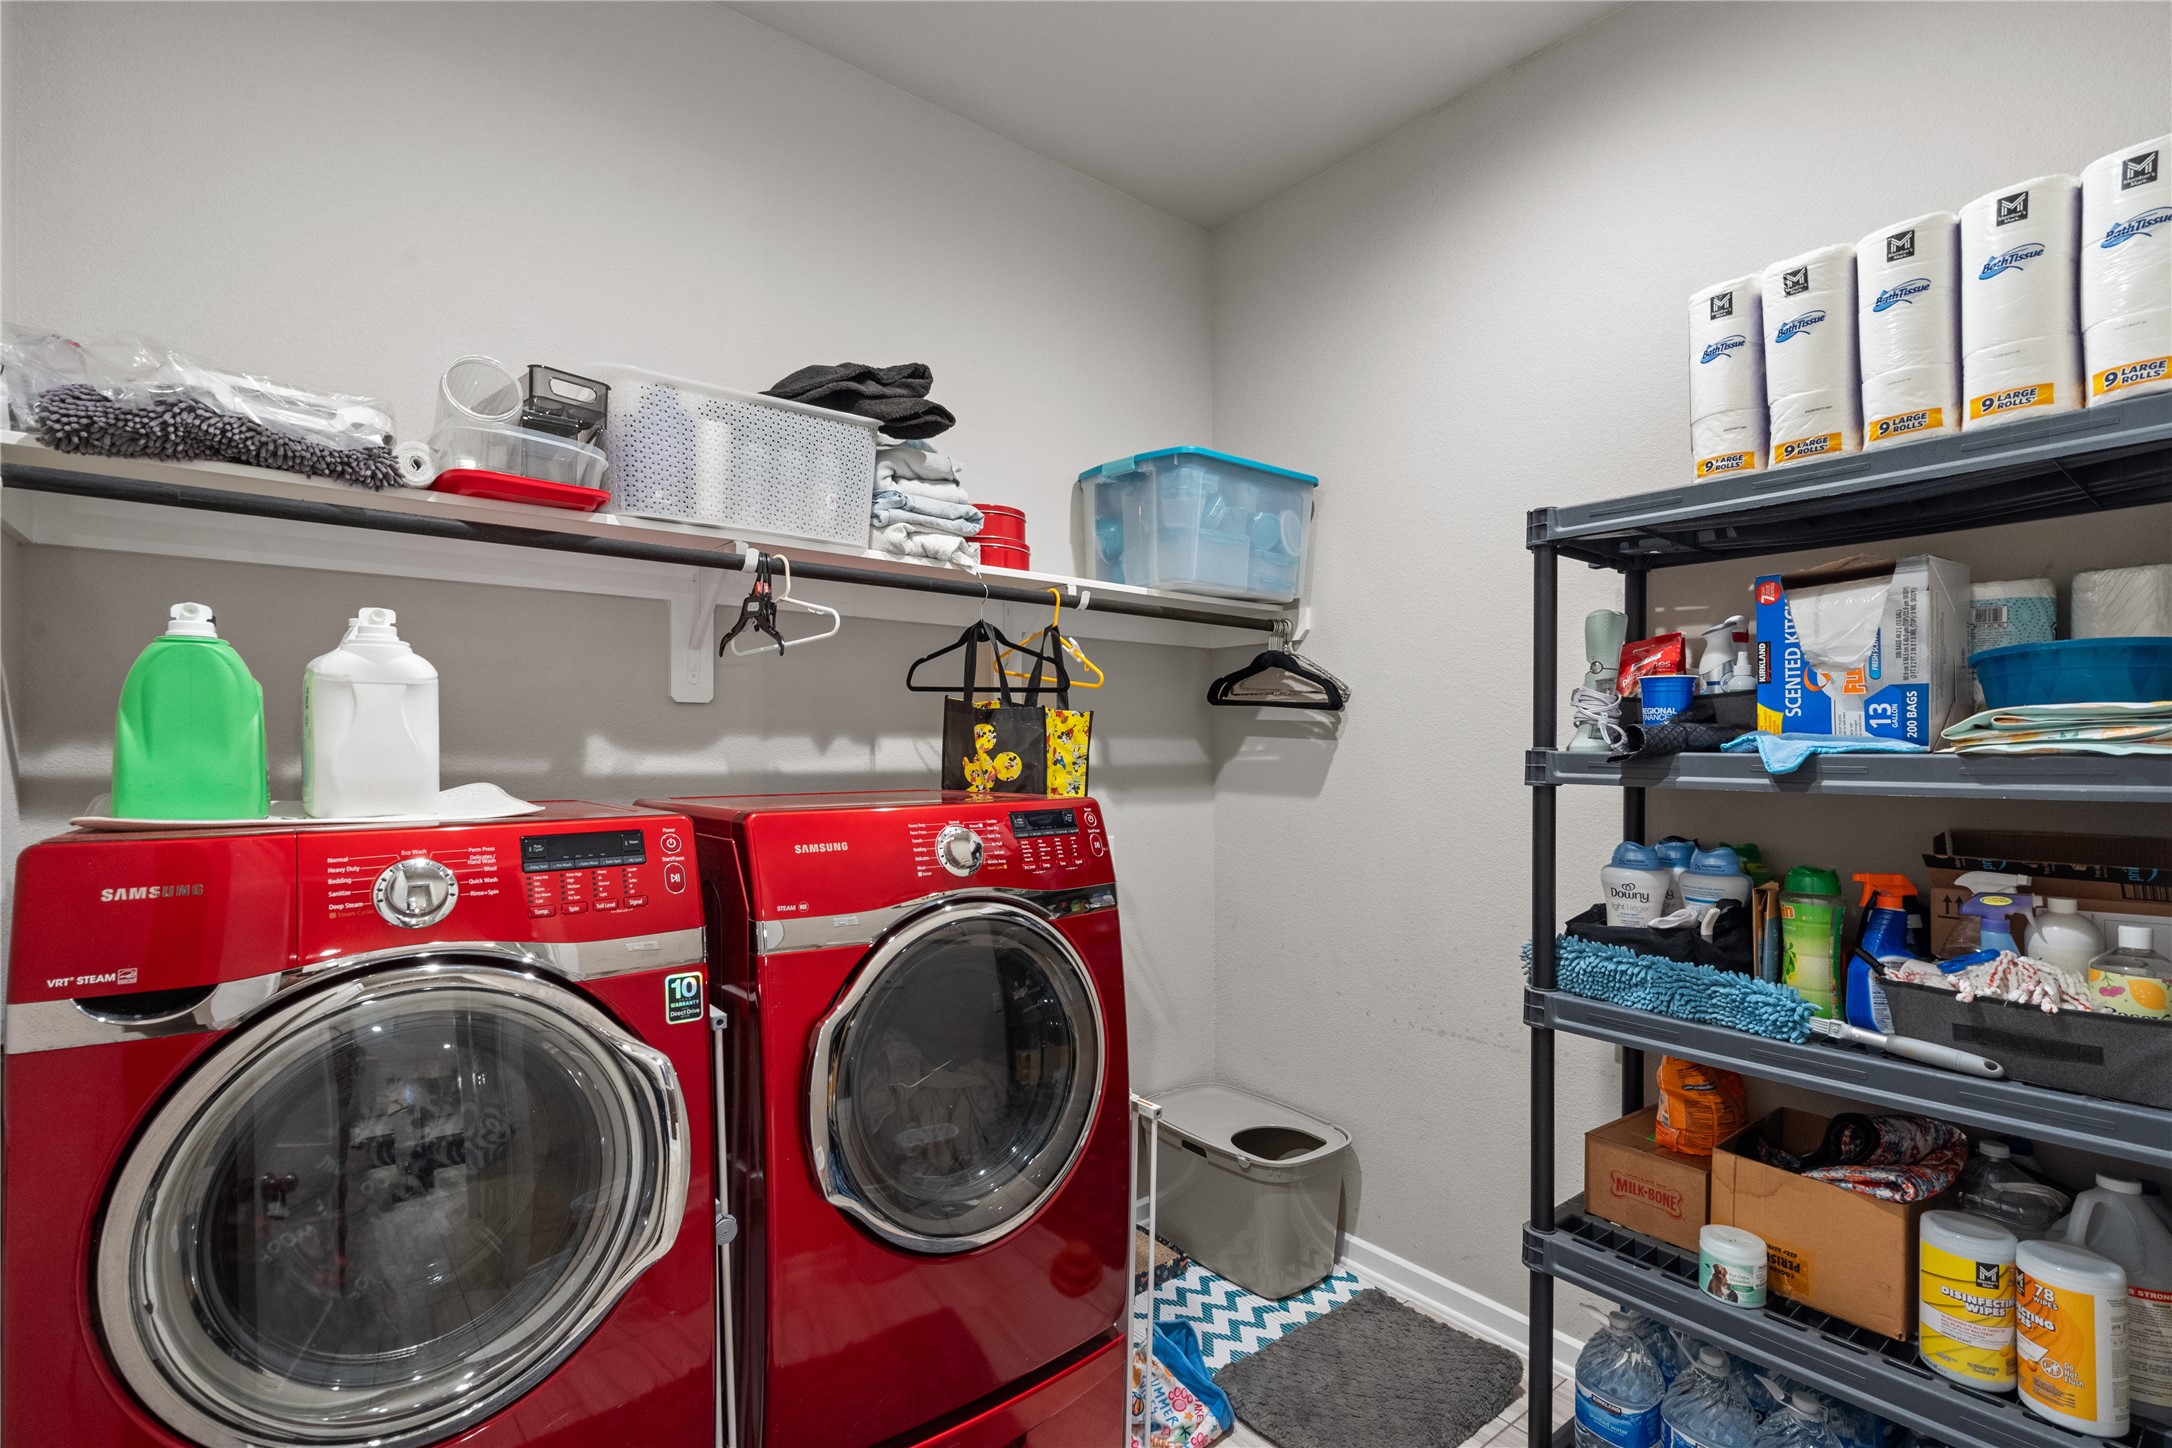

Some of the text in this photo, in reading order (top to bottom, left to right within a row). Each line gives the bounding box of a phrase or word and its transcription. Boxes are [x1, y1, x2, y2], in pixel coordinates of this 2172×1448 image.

[2121, 360, 2167, 376] LARGE
[2104, 372, 2118, 388] 9
[1997, 388, 2037, 402] LARGE
[1981, 398, 1995, 412] 9
[1892, 412, 1927, 426] LARGE
[1879, 422, 1890, 435] 9
[1797, 436, 1828, 449] LARGE
[1784, 444, 1795, 457] 9
[1715, 455, 1744, 463] LARGE
[1705, 461, 1714, 473] 9
[1761, 595, 1775, 604] 7
[1758, 642, 1766, 682] KIRKLAND
[1784, 599, 1801, 717] SCENTED KITC
[1869, 703, 1891, 729] 13
[1891, 703, 1899, 728] GALLON
[1907, 691, 1917, 738] 200 BAGS
[794, 841, 848, 854] SAMSUNG
[327, 865, 360, 874] Heavy Duty
[100, 884, 203, 902] SAMSUNG
[1611, 887, 1649, 903] Downy
[328, 903, 344, 911] Deep
[76, 973, 116, 985] STEAM
[671, 977, 697, 999] 10
[670, 1000, 699, 1008] WARRANTY
[670, 1009, 686, 1017] Direct
[1616, 1177, 1676, 1212] MILK-BONE
[1940, 1285, 2016, 1309] DISINFECTIN
[2035, 1283, 2055, 1302] 78
[1965, 1302, 2006, 1317] WIPES
[2033, 1295, 2058, 1311] WIPES
[2064, 1362, 2074, 1371] Do
[2064, 1370, 2078, 1379] Not
[2064, 1376, 2084, 1388] Flush
[1151, 1373, 1178, 1426] UMMER
